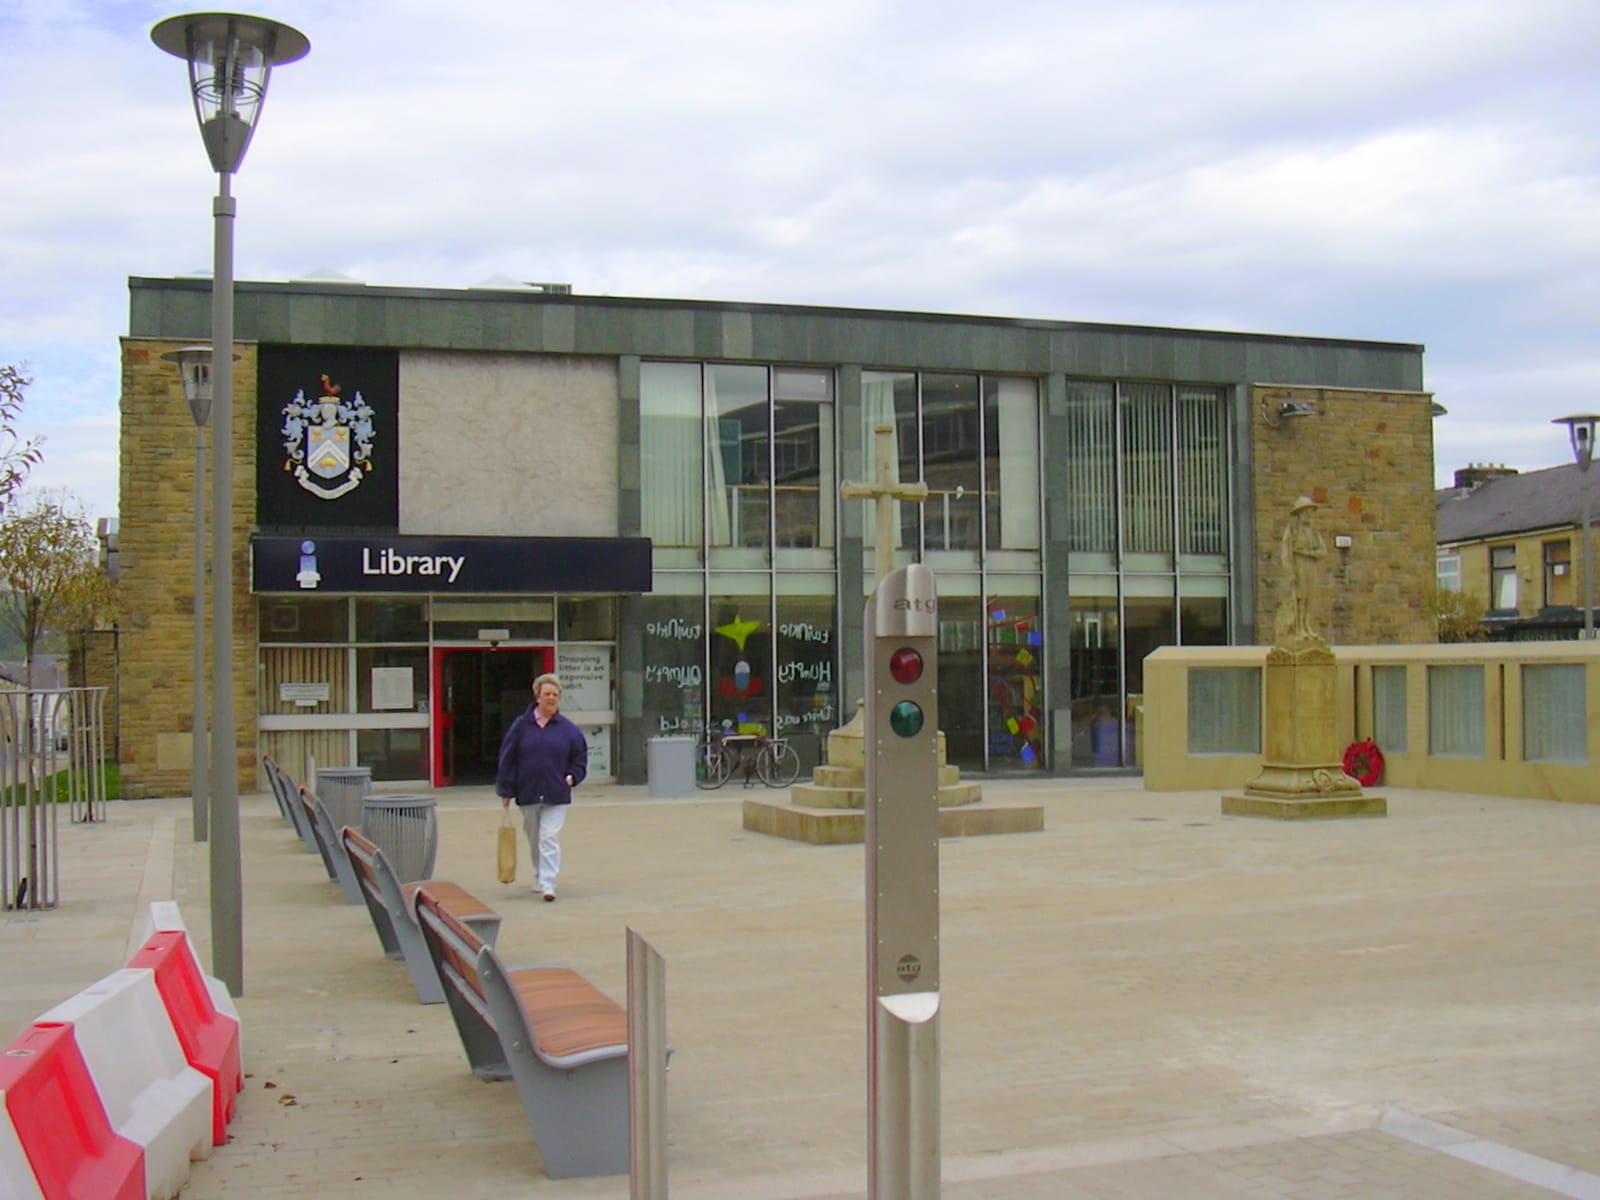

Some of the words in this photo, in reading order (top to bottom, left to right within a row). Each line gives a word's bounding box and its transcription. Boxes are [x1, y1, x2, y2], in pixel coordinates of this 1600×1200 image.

[362, 547, 465, 583] Library
[893, 598, 936, 614] atg
[559, 655, 600, 664] Dropping
